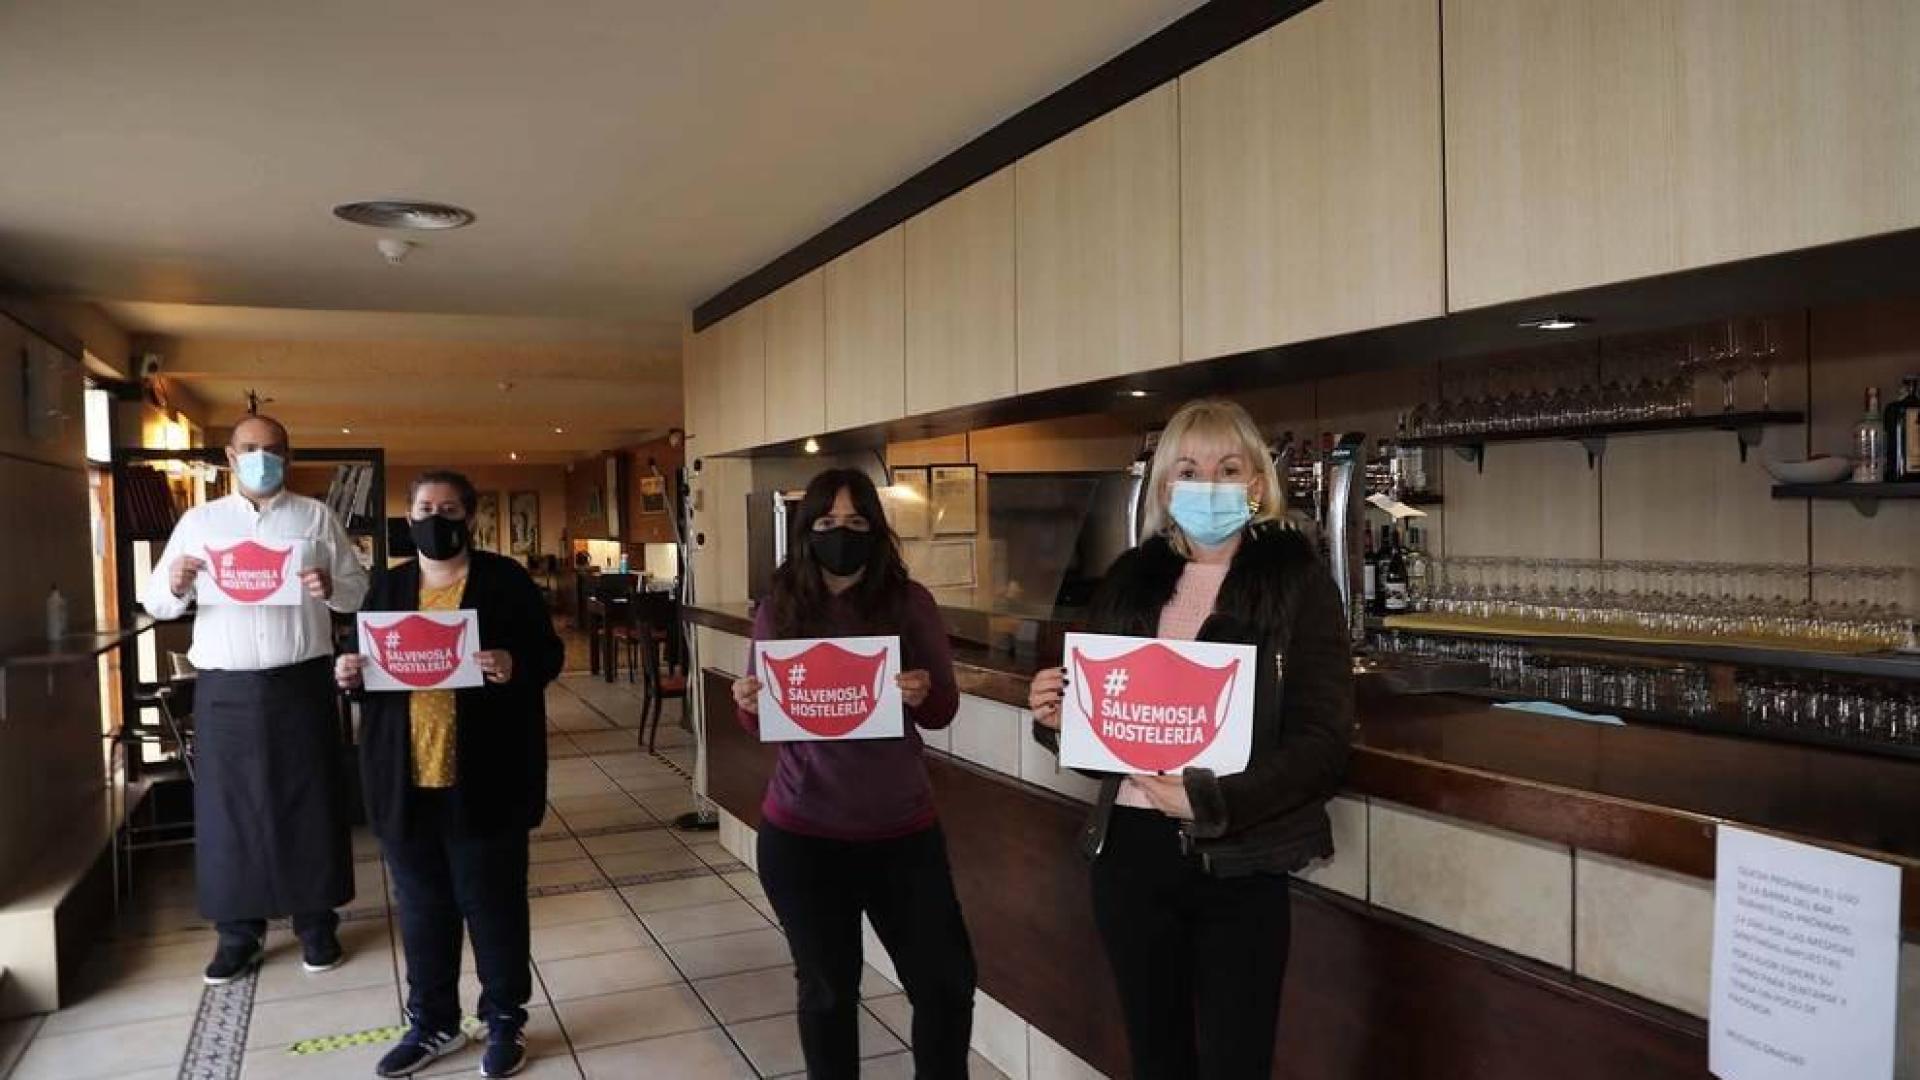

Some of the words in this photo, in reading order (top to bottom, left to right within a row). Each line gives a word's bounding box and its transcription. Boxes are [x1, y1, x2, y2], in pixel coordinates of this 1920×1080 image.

[788, 663, 807, 685] #
[1103, 669, 1129, 696] #
[788, 684, 868, 703] SALVEMOSLA
[1101, 698, 1207, 725] SALVEMOSLA
